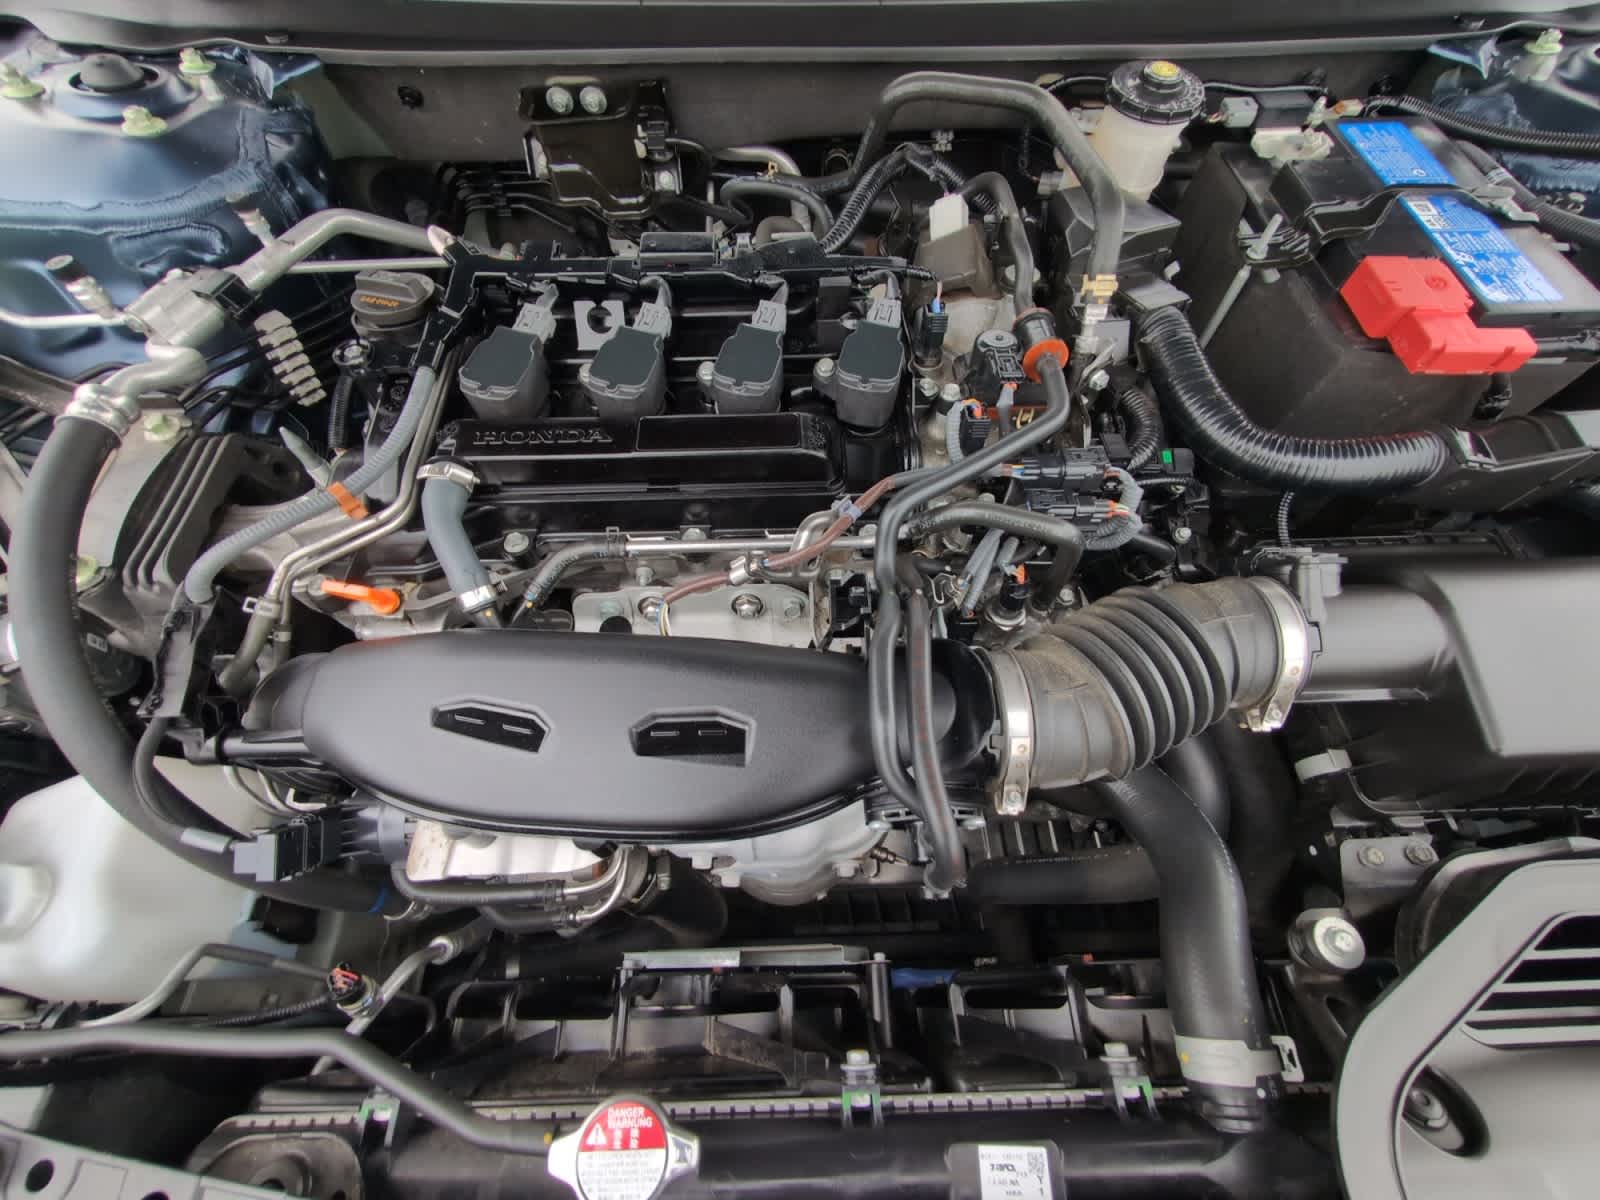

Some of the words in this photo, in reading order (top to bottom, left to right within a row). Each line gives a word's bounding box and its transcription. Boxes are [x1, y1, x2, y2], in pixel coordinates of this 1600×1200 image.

[472, 428, 613, 446] HONDA
[607, 1106, 645, 1117] DANGER
[607, 1117, 653, 1129] WARNUNG
